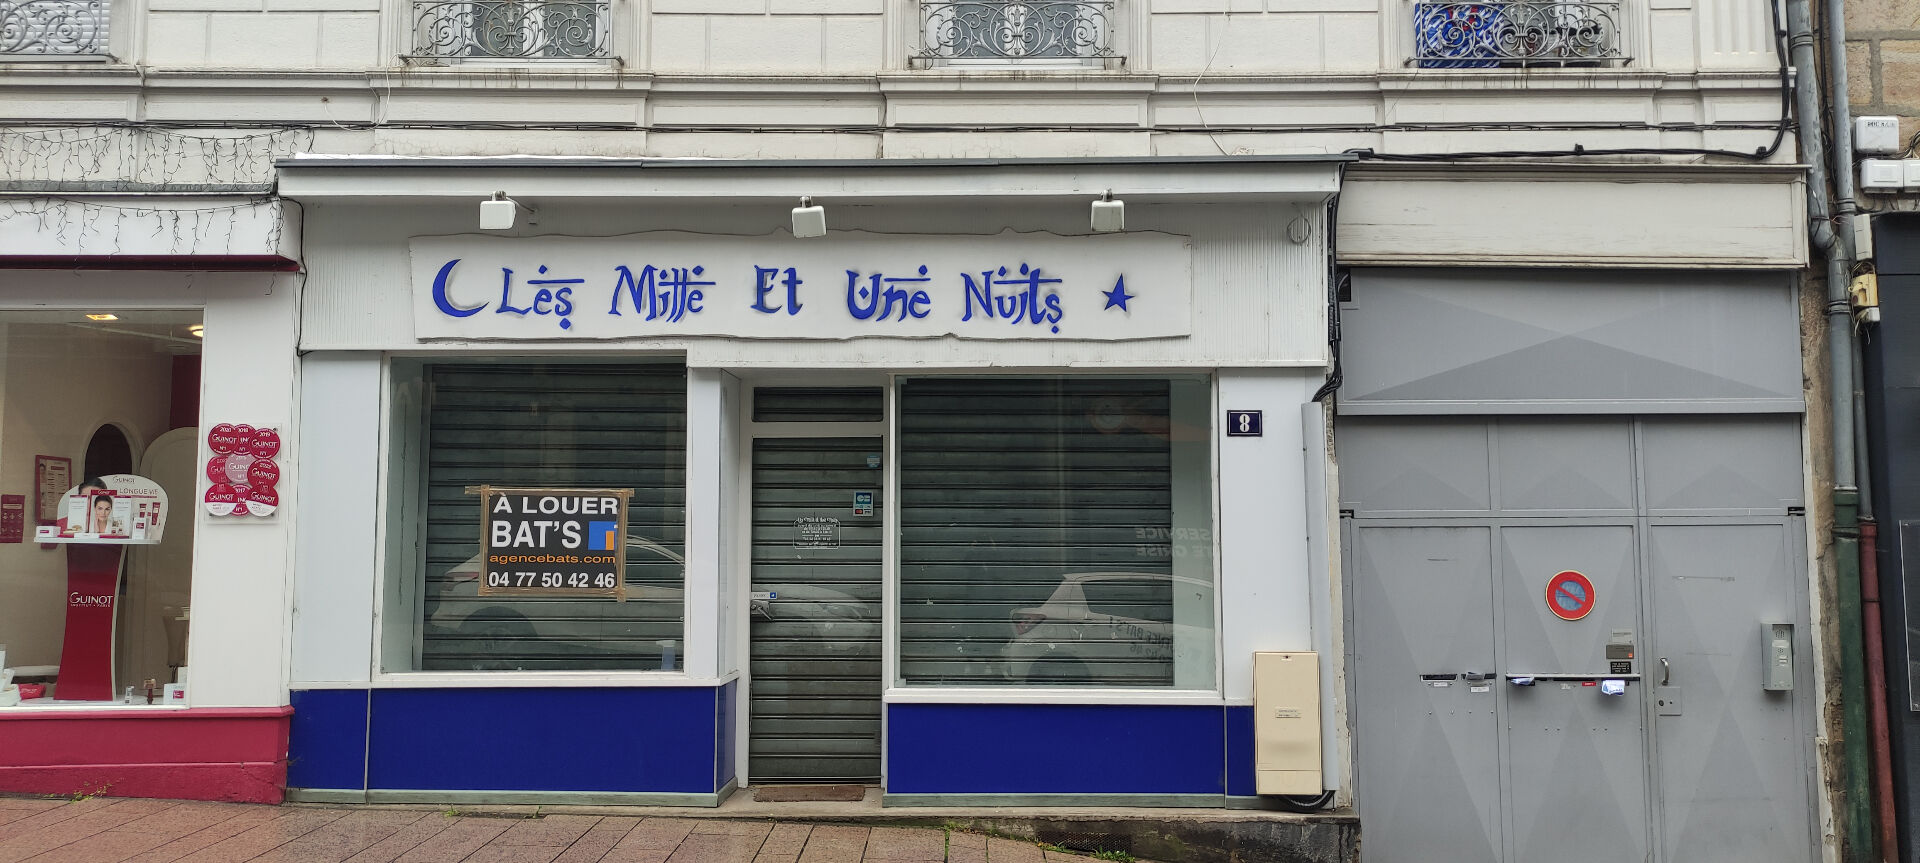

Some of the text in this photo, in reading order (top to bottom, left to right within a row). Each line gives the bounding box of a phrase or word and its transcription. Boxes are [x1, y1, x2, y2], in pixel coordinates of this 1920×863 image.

[496, 262, 1063, 335] Les Mille Et Une Nuits
[1239, 413, 1250, 432] 8
[211, 433, 237, 444] GUINOT
[251, 438, 278, 448] GUINOT
[208, 492, 234, 501] GUINOT
[493, 492, 618, 515] À LOUER
[491, 520, 582, 549] BAT'S
[489, 554, 616, 565] agencebats.com
[488, 571, 615, 588] 04 77 50 42 46
[69, 591, 114, 604] GUINOT
